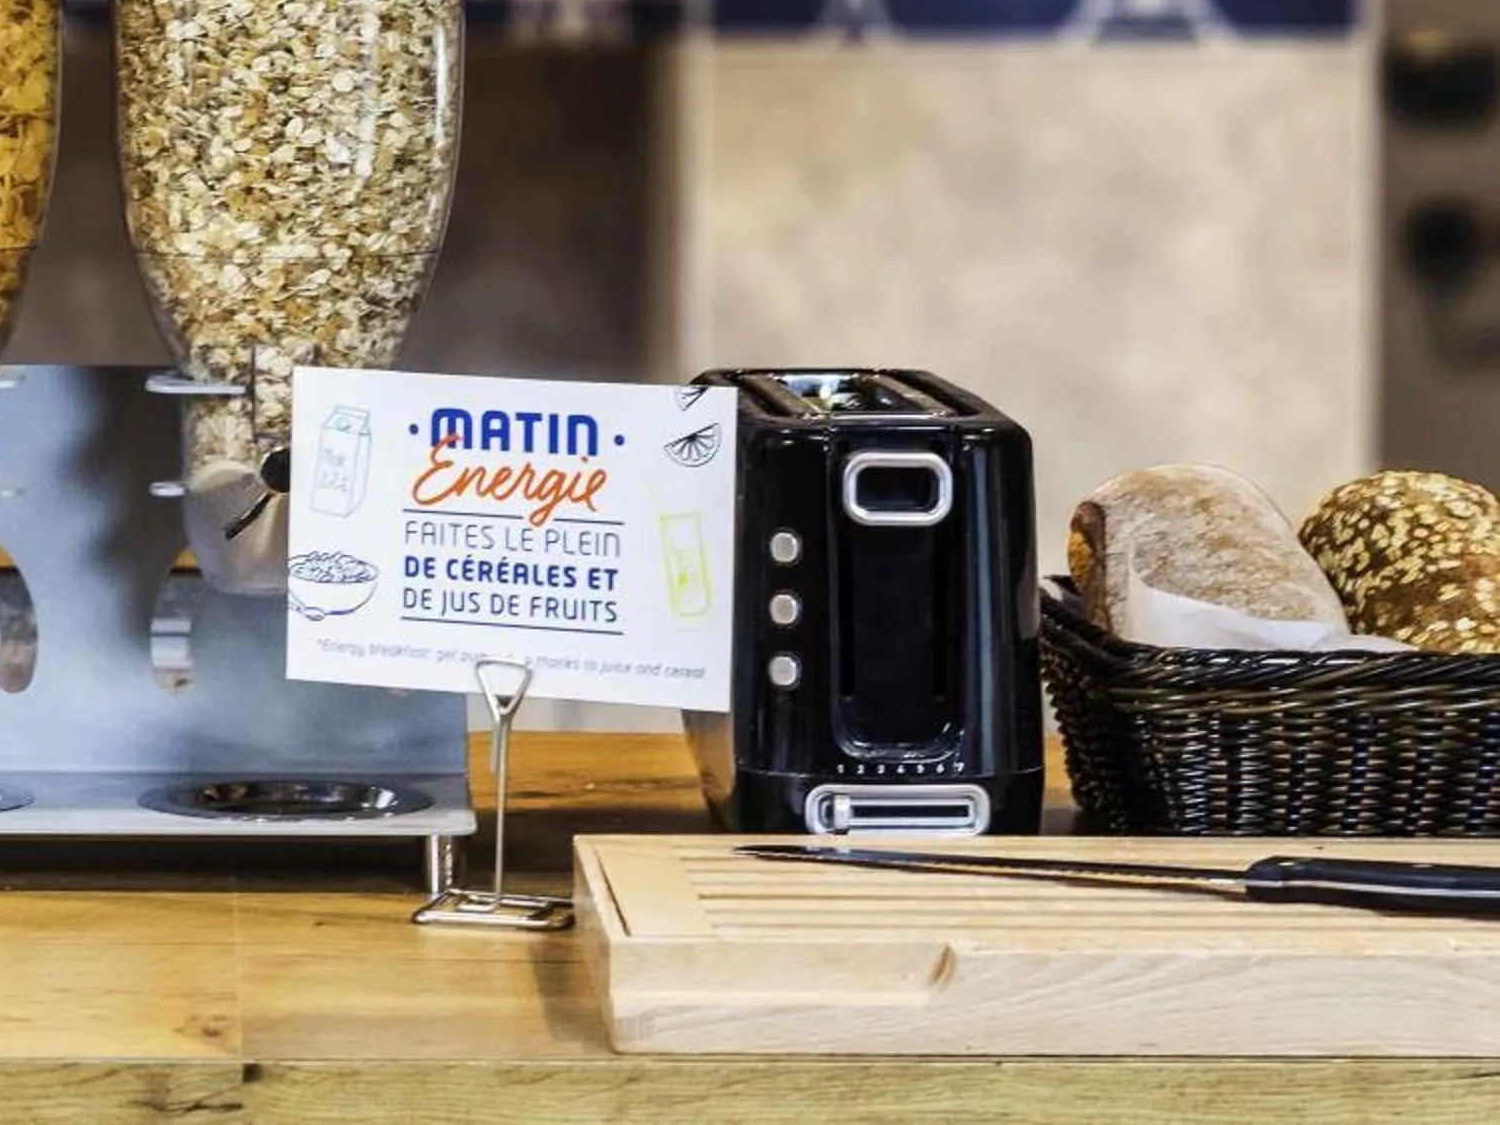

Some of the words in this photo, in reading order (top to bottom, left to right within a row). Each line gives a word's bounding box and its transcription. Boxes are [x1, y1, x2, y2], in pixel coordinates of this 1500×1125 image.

[431, 407, 598, 457] MATIN
[404, 520, 496, 550] FAITES
[505, 527, 534, 552] LE
[544, 529, 621, 558] PLEIN
[404, 555, 436, 579] DE
[446, 555, 576, 588] CÉRÉALES
[587, 568, 618, 591] ET
[403, 587, 433, 610] DE
[441, 590, 480, 616] JUS
[490, 594, 520, 616] DE
[529, 596, 617, 623] FRUITS
